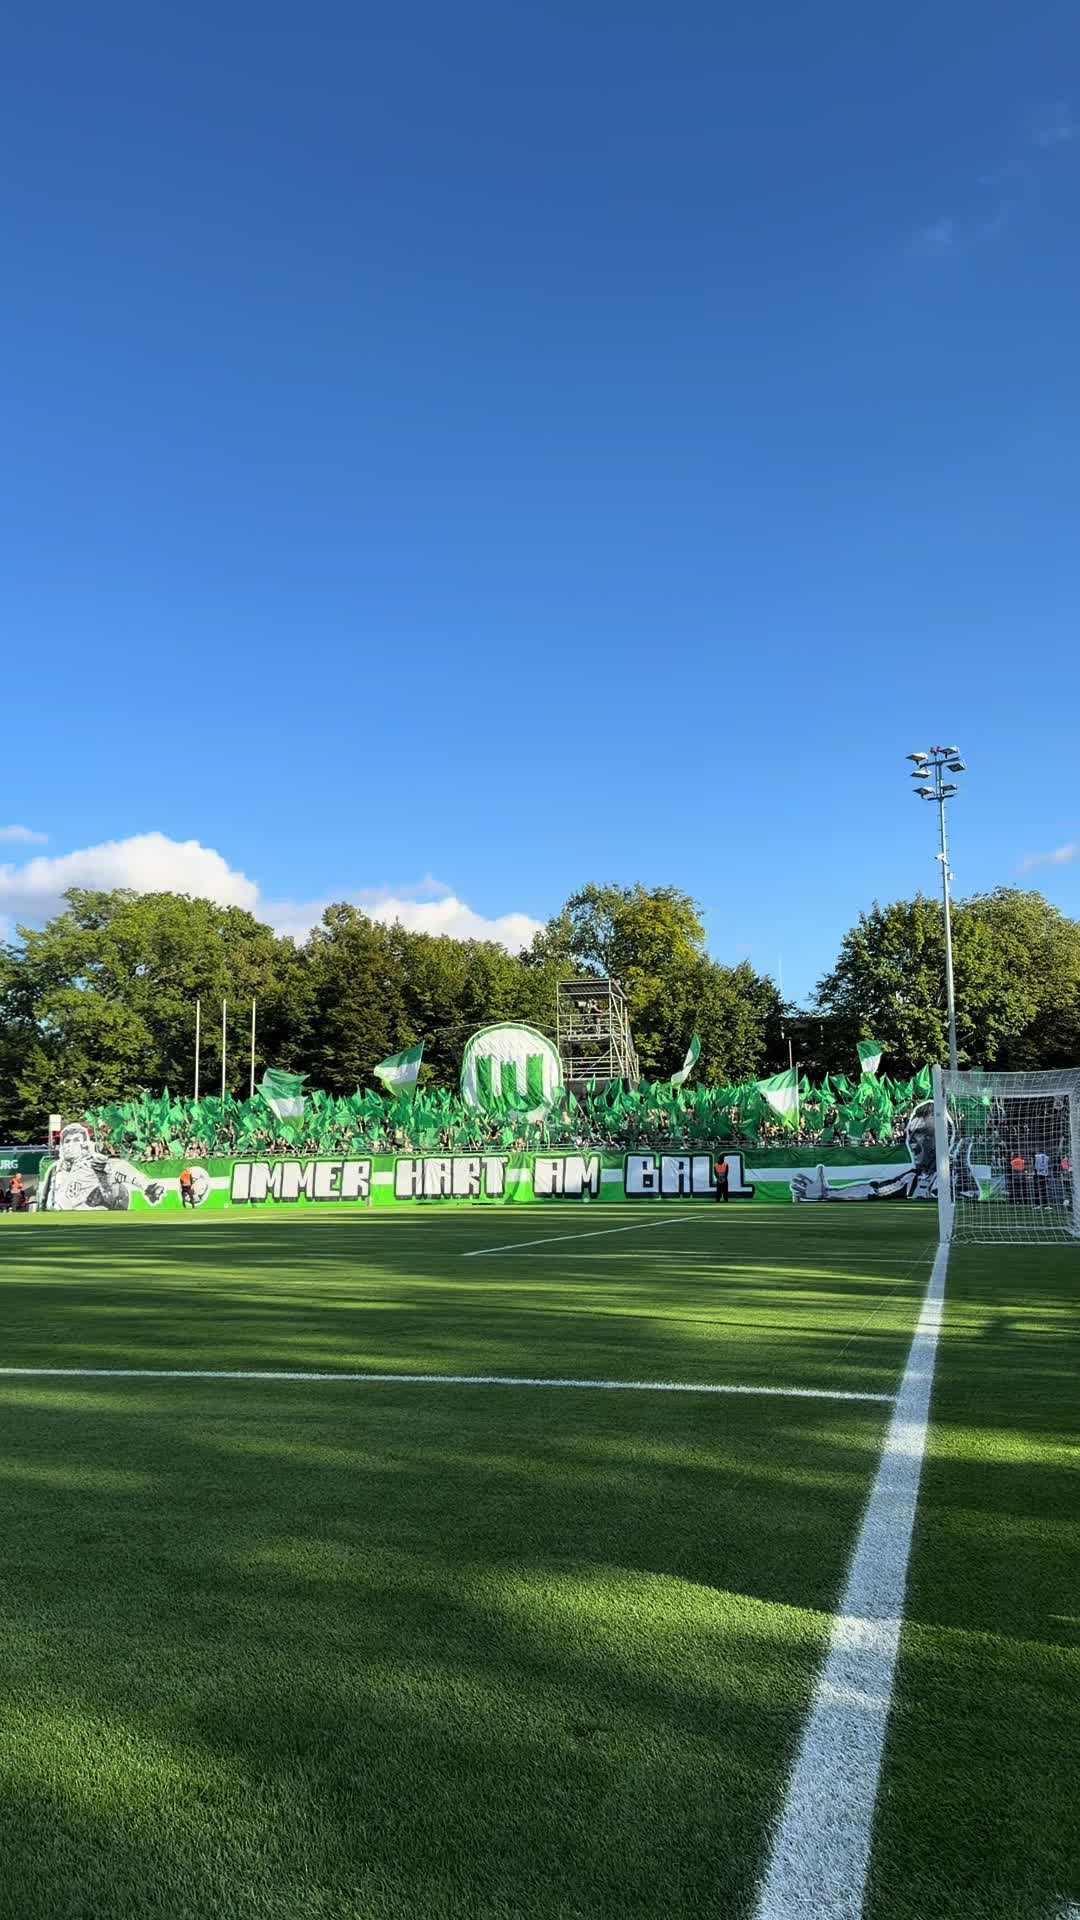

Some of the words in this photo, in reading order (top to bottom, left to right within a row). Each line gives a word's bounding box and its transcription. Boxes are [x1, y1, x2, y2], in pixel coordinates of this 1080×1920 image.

[231, 1158, 372, 1204] IMMER
[394, 1155, 510, 1200] HART
[532, 1153, 601, 1199] AM
[625, 1152, 755, 1198] BALL
